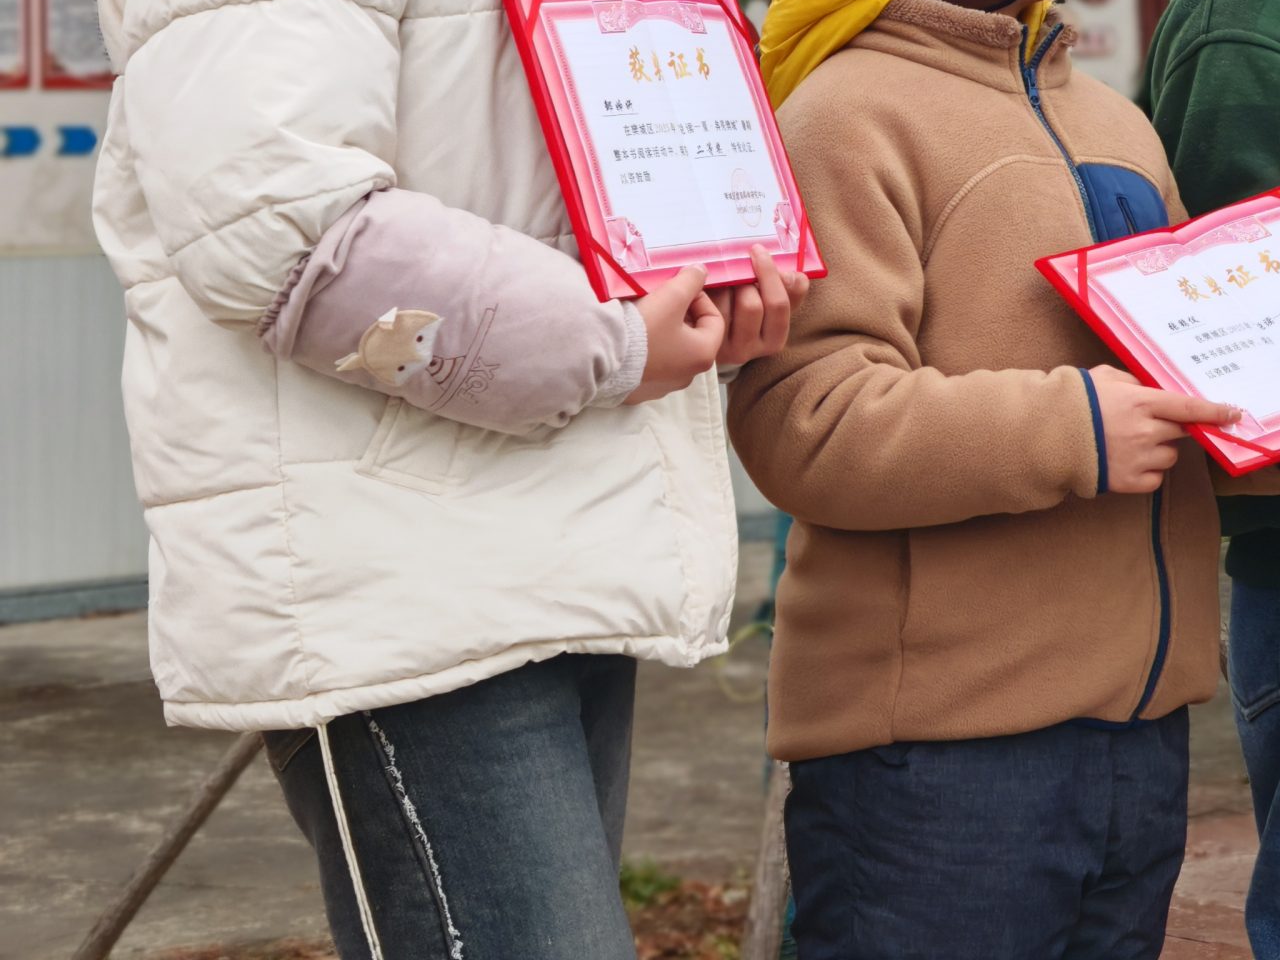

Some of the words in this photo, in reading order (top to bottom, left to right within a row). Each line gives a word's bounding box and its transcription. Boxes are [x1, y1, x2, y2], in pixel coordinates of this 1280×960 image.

[629, 45, 710, 81] 获奖证书
[1177, 249, 1280, 302] 获奖证书
[456, 356, 501, 405] FOX
